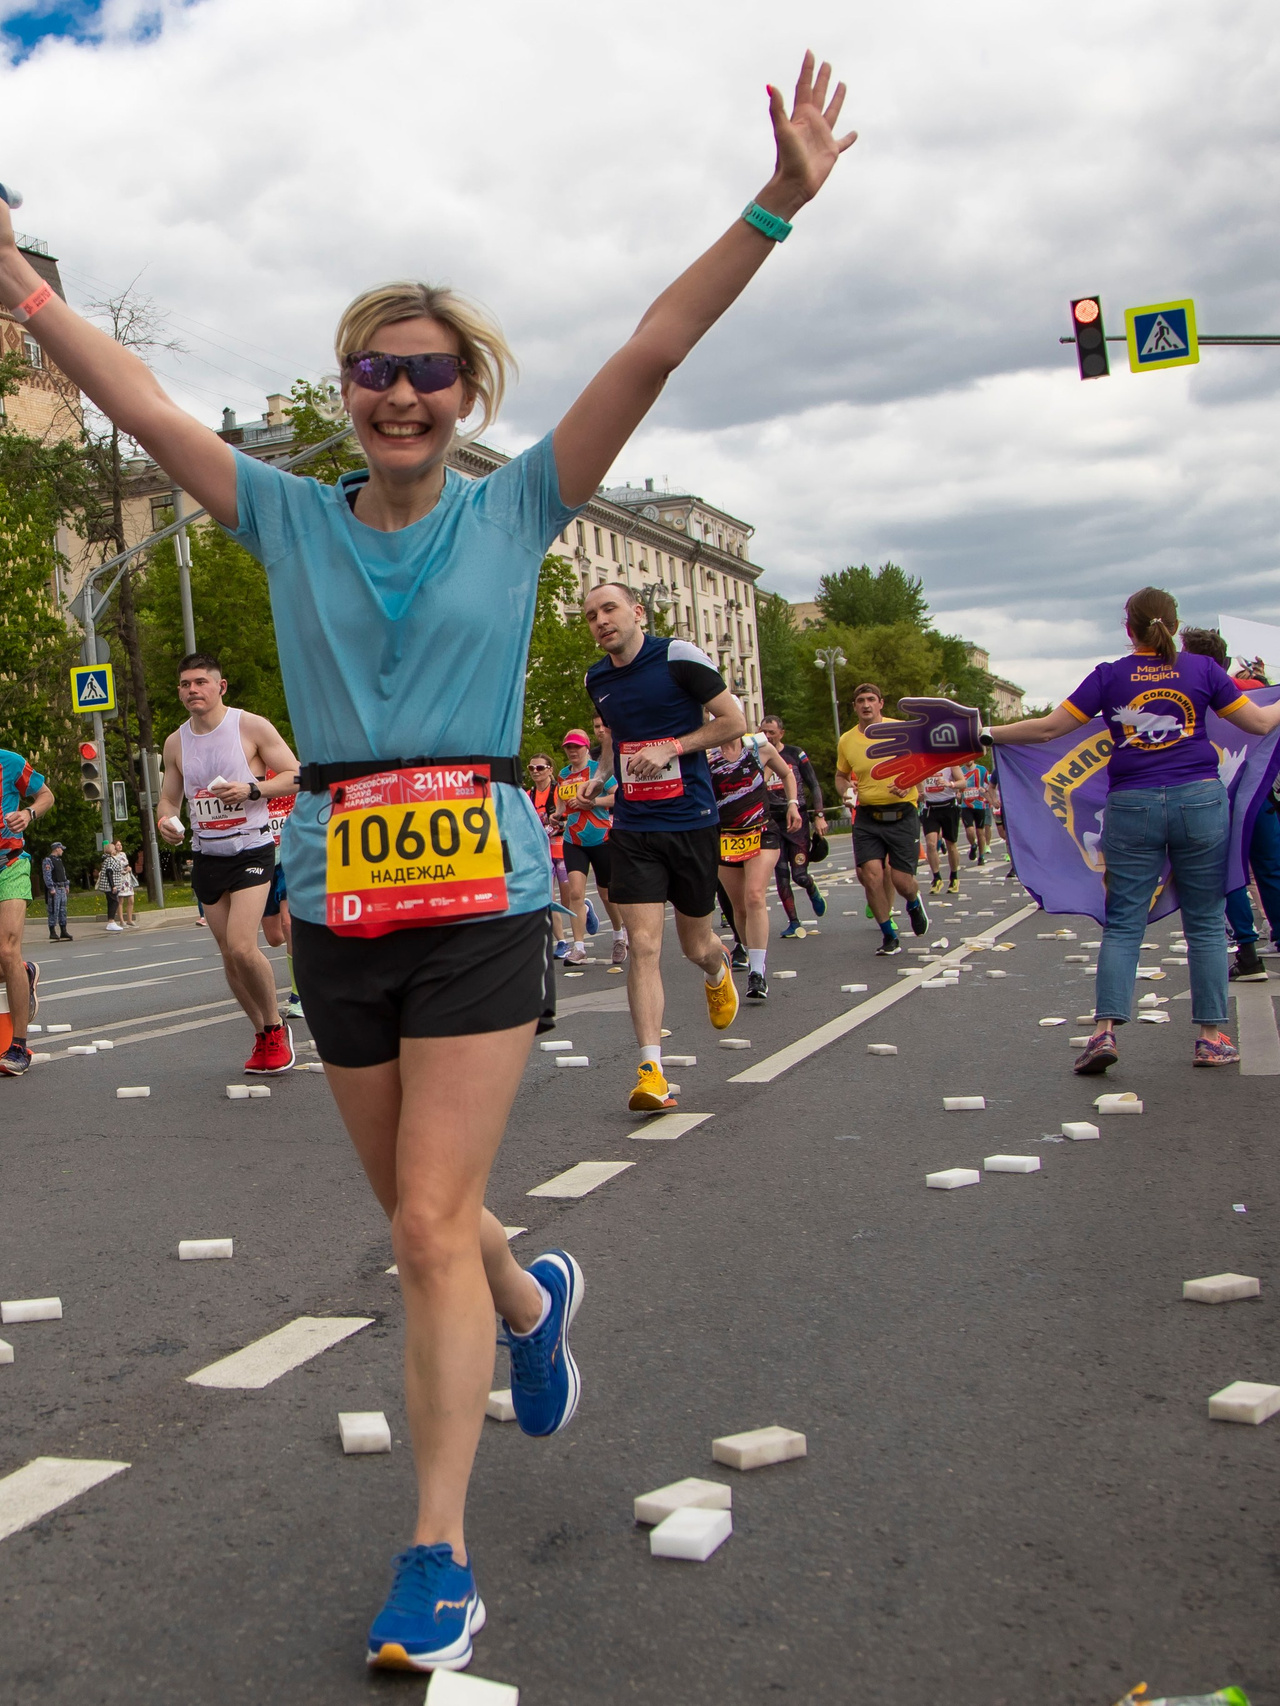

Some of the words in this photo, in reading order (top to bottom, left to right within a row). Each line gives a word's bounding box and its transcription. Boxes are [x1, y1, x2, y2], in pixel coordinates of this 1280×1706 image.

[1136, 664, 1173, 673] Maria
[1130, 671, 1180, 682] Dolgikh
[1143, 690, 1195, 724] СОКОЛЬНИКИ
[455, 787, 475, 796] 2023
[627, 783, 634, 794] D
[344, 794, 383, 809] МАРАФОН
[334, 806, 491, 867] 10609
[722, 835, 760, 850] 12310
[371, 863, 456, 885] НАДЕЖДА
[474, 892, 493, 901] МИР
[342, 894, 362, 922] D
